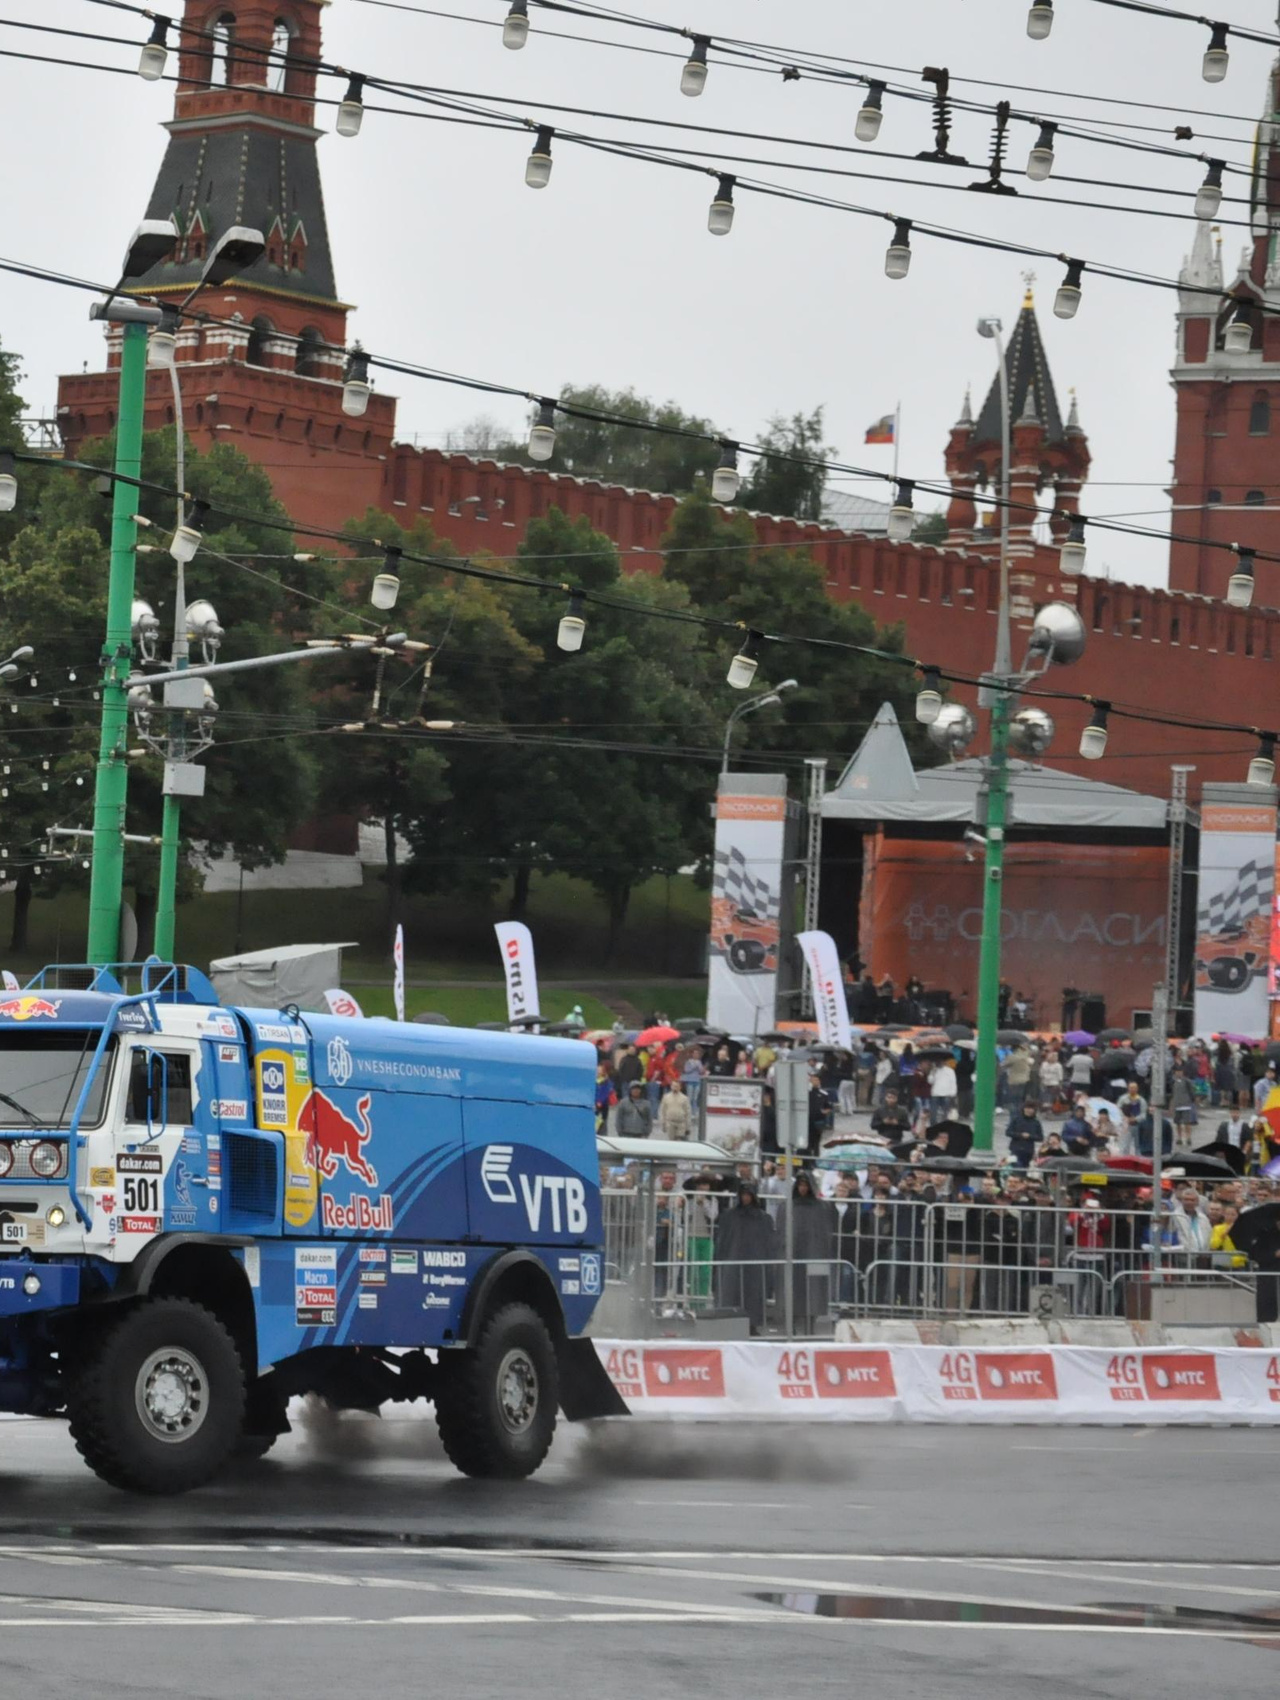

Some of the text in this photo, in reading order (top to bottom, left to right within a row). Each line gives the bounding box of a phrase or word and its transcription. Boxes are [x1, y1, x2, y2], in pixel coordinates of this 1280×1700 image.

[957, 908, 1167, 946] СОГЛАСИ
[357, 1059, 461, 1081] VNESHECONOMBANK
[219, 1102, 245, 1117] Castrol
[263, 1099, 286, 1111] KNORR
[263, 1112, 287, 1123] BREMSE
[120, 1157, 160, 1170] dakar.com
[124, 1177, 158, 1212] 501
[519, 1174, 587, 1233] VTB
[322, 1193, 393, 1231] Red Bull
[7, 1226, 24, 1237] 501
[125, 1219, 154, 1231] TOTAL
[300, 1253, 333, 1263] dakar.com
[423, 1251, 466, 1267] WABCO
[304, 1271, 327, 1284] Macro
[306, 1290, 335, 1304] TOTAL
[607, 1349, 639, 1381] 4G
[777, 1351, 809, 1381] 4G
[939, 1353, 973, 1383] 4G
[1106, 1355, 1139, 1384] 4G
[1266, 1356, 1280, 1385] 4
